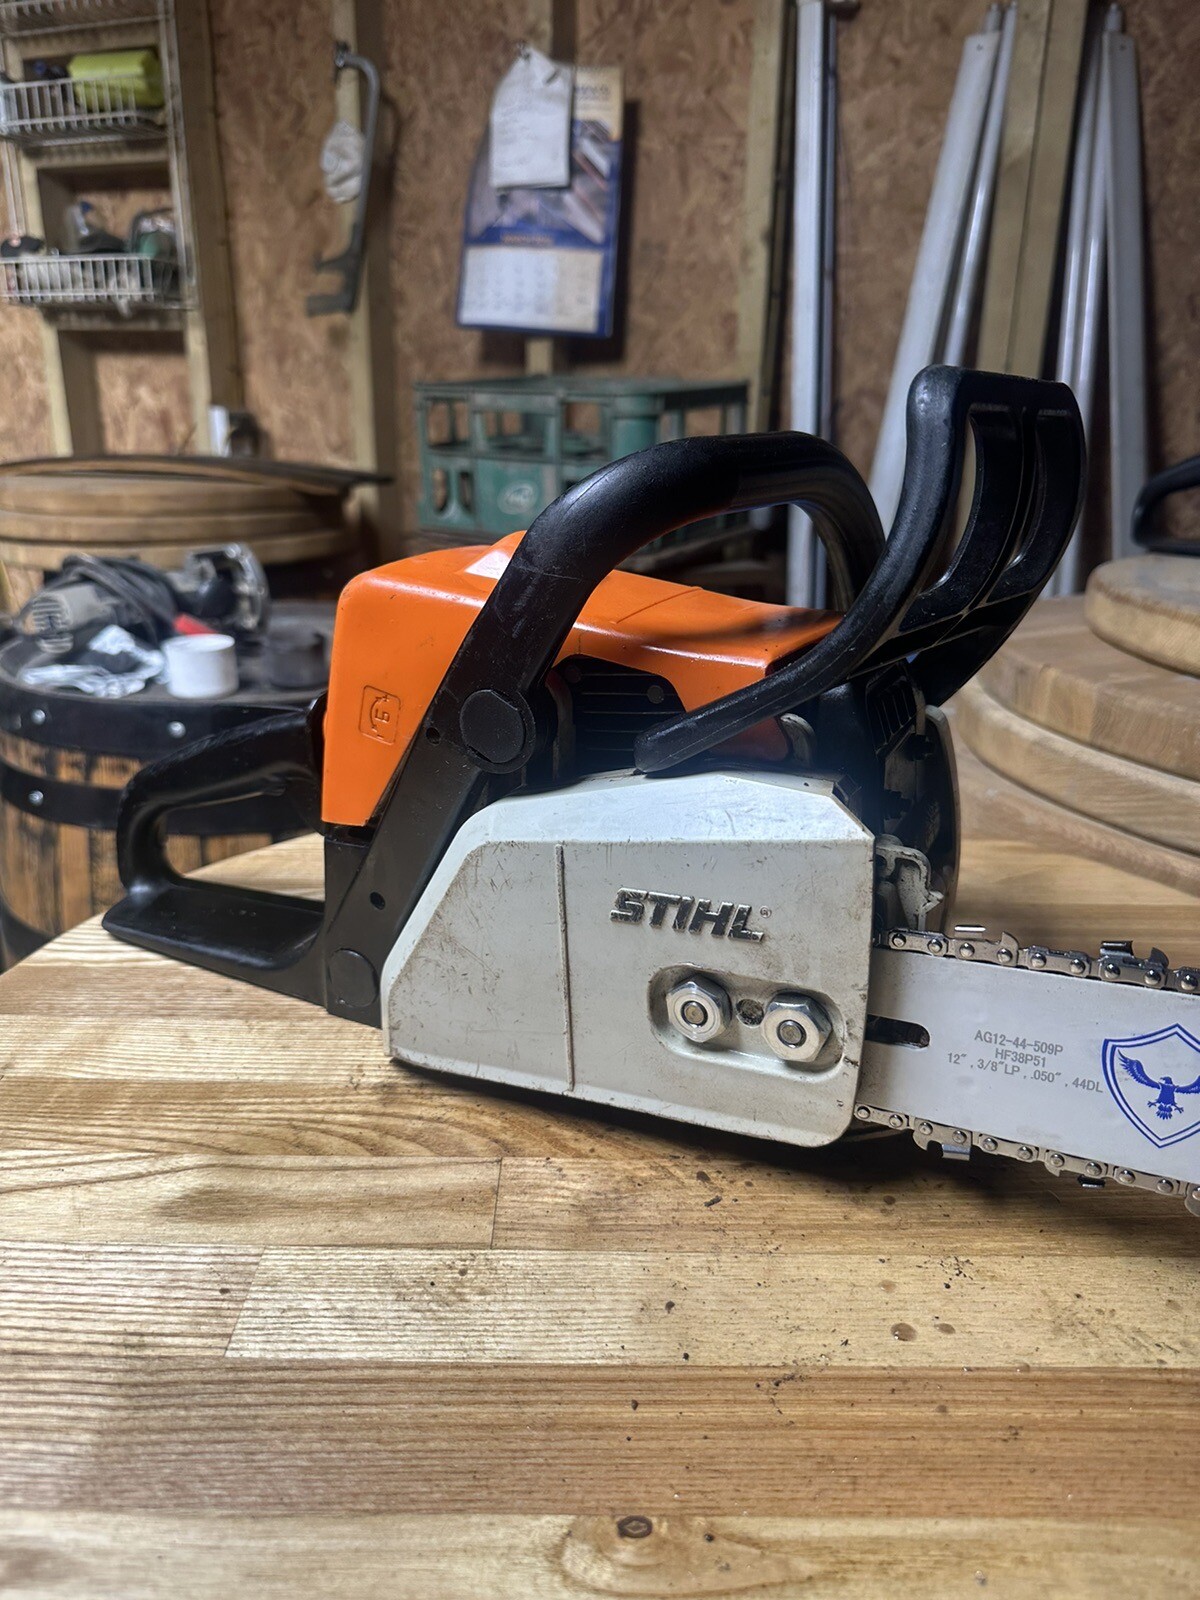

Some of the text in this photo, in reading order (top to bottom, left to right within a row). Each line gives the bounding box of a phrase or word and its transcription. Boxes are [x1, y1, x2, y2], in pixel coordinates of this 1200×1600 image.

[610, 887, 764, 942] STIHL
[974, 1029, 1064, 1056] AG12-44-509P
[994, 1047, 1047, 1068] HF38P51
[1072, 1077, 1104, 1093] 44DL
